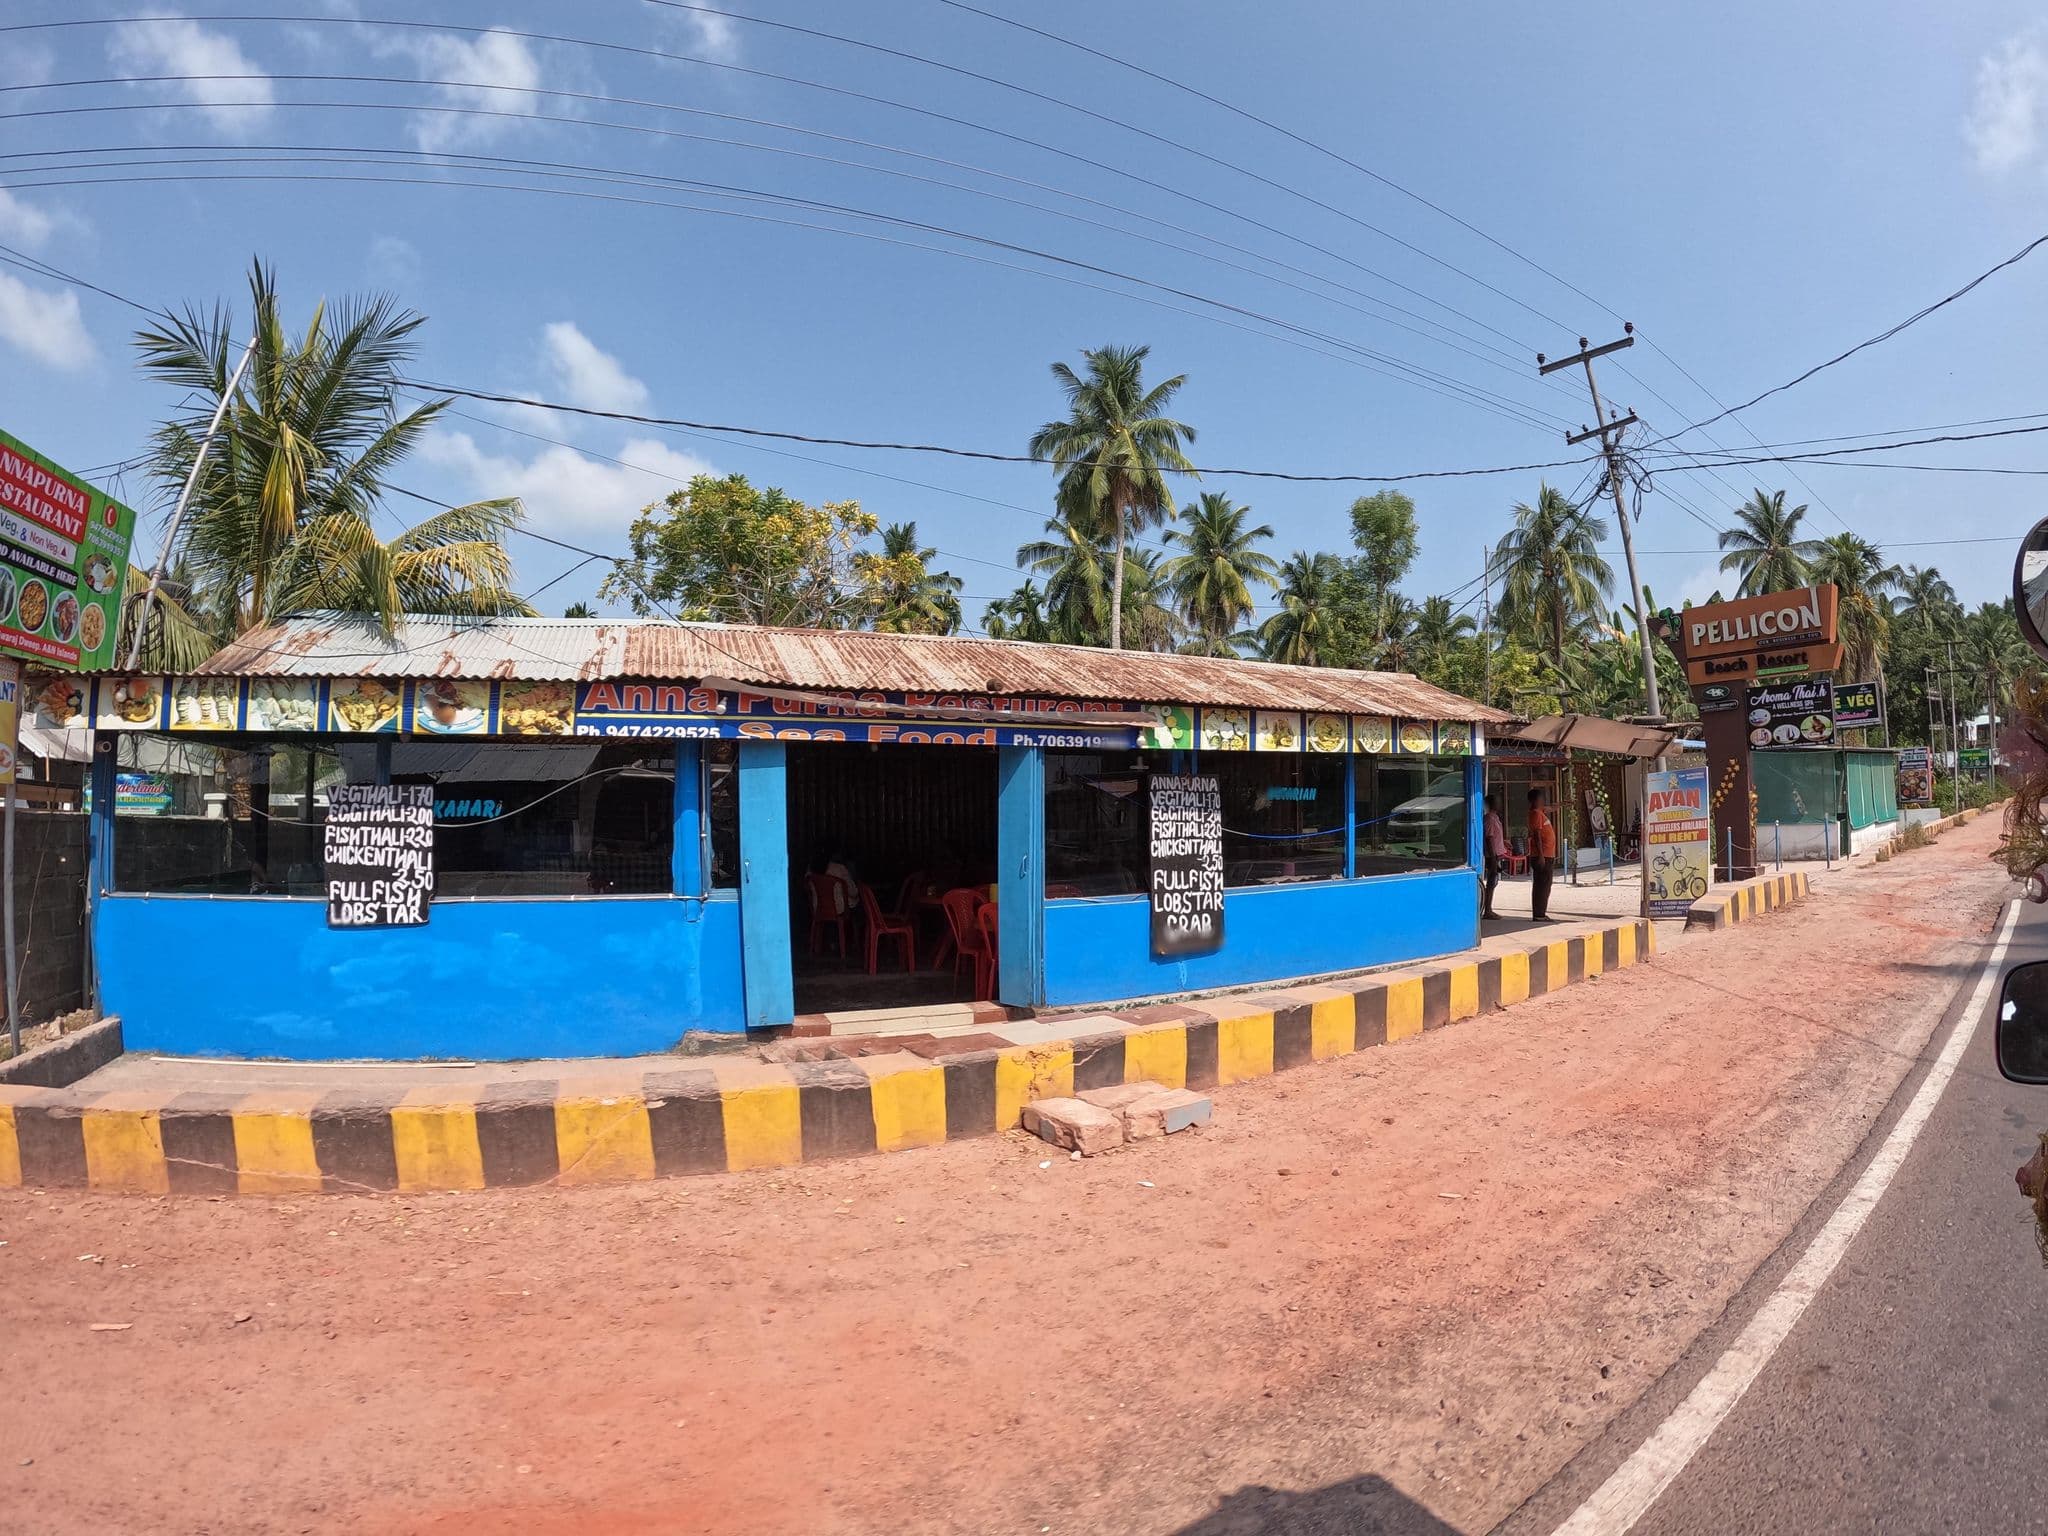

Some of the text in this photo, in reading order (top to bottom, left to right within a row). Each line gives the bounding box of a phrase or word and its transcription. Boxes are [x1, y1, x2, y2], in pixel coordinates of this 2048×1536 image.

[20, 528, 27, 542] &
[8, 549, 57, 577] AVAILABLE
[56, 567, 78, 586] HERE
[1691, 586, 1822, 646] PELLICON
[1704, 657, 1748, 675] Beach
[1756, 652, 1808, 668] Resort
[581, 683, 718, 713] Anna
[1750, 688, 1792, 706] Aroma
[1846, 693, 1875, 708] VEG
[738, 722, 997, 745] Sea Food
[1150, 776, 1218, 792] ANNAPURNA
[1649, 787, 1701, 813] AYAN
[1668, 831, 1700, 842] RENT
